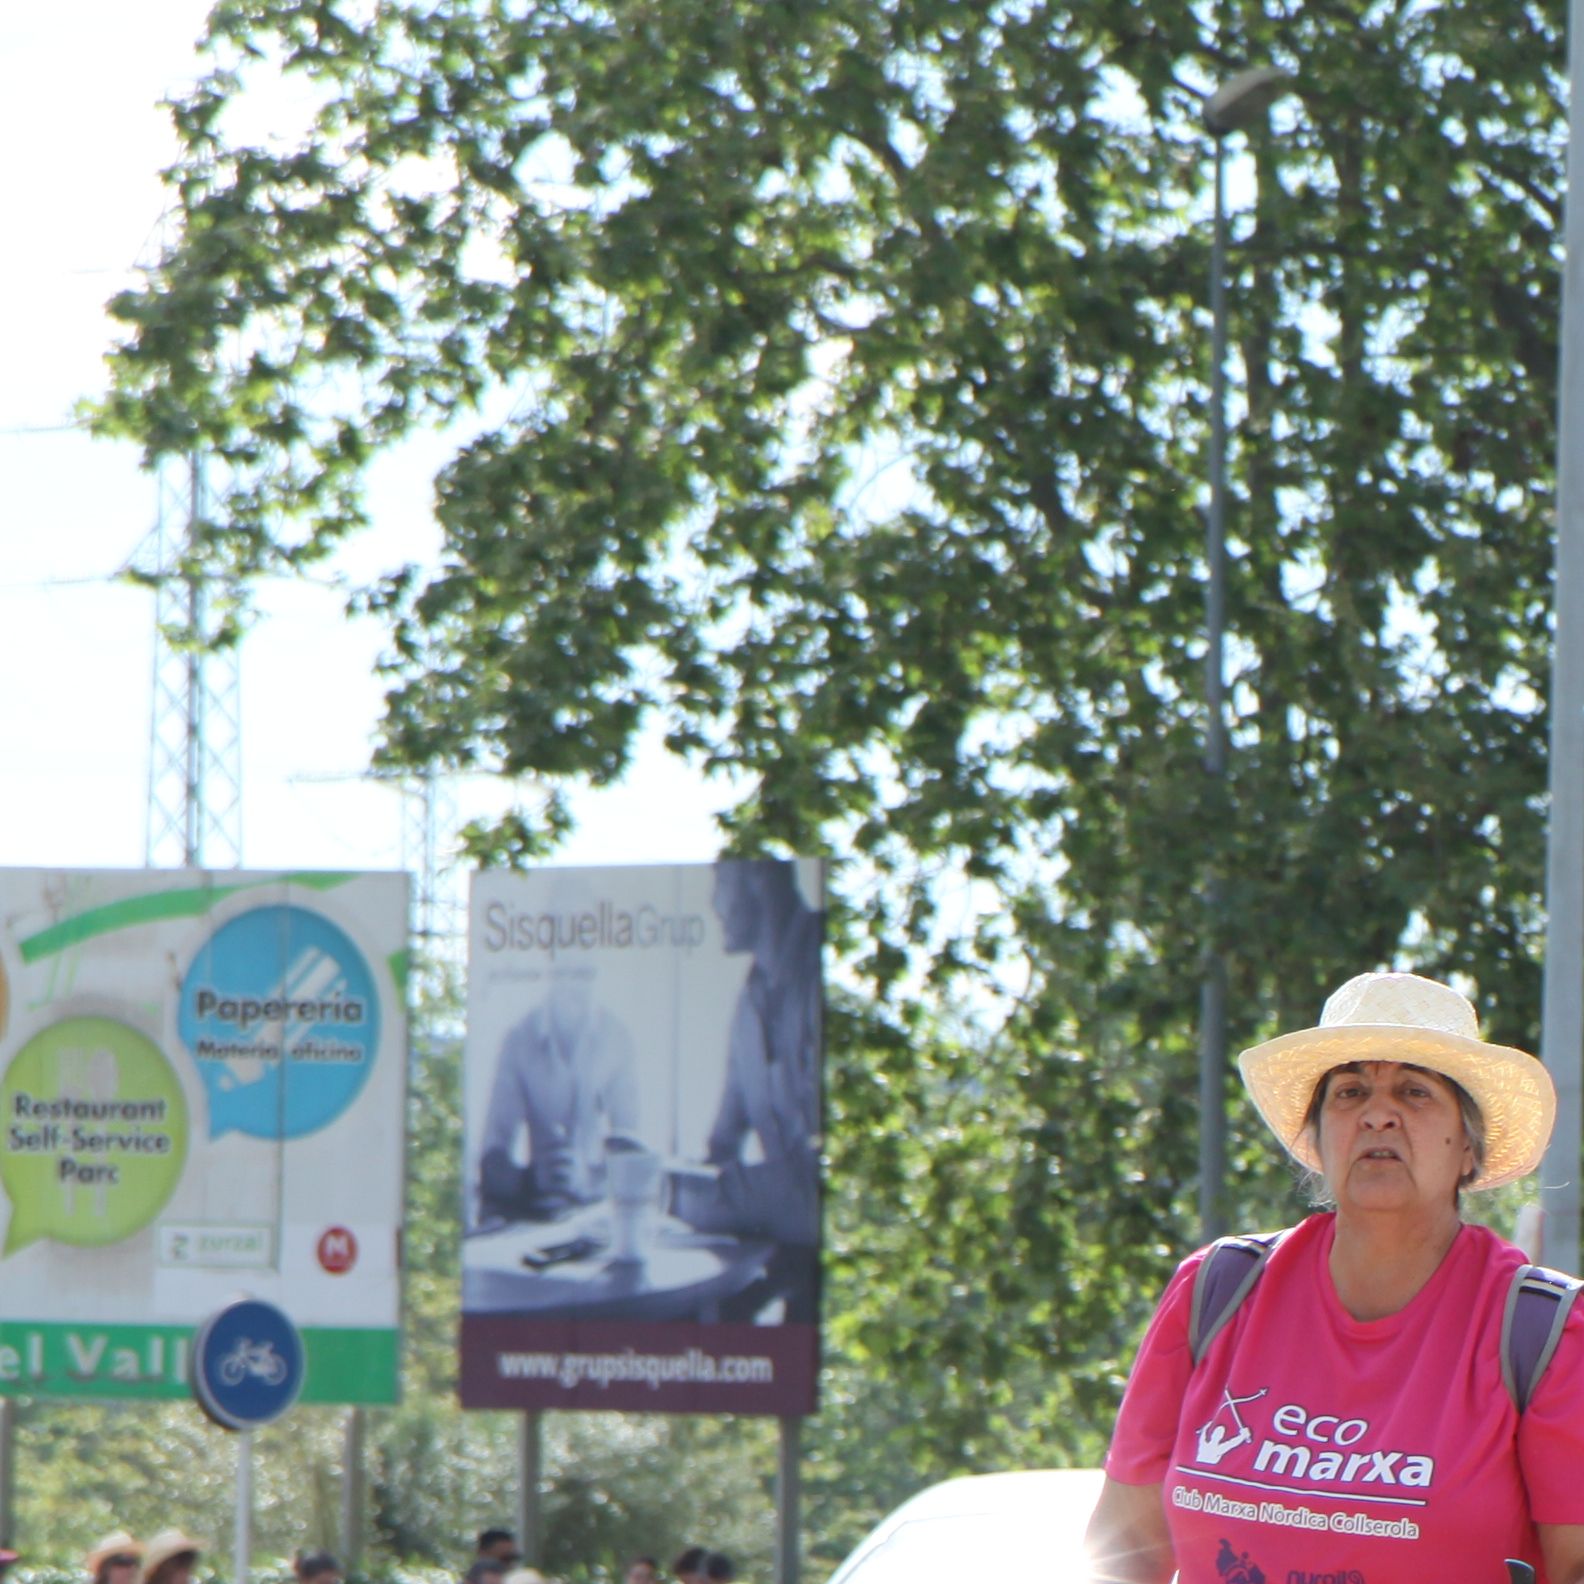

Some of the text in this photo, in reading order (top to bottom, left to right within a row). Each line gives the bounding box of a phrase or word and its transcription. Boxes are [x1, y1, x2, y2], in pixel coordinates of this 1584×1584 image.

[197, 991, 362, 1028] Papereria
[15, 1094, 166, 1120] Restaurant
[10, 1125, 171, 1151] Self-Service
[60, 1157, 120, 1184] Parc
[498, 1347, 774, 1390] www.grupsisquella.com
[1273, 1403, 1368, 1446] eco
[1253, 1438, 1434, 1488] marxa
[1173, 1486, 1419, 1539] Club Marxa Nòrdica Collserola
